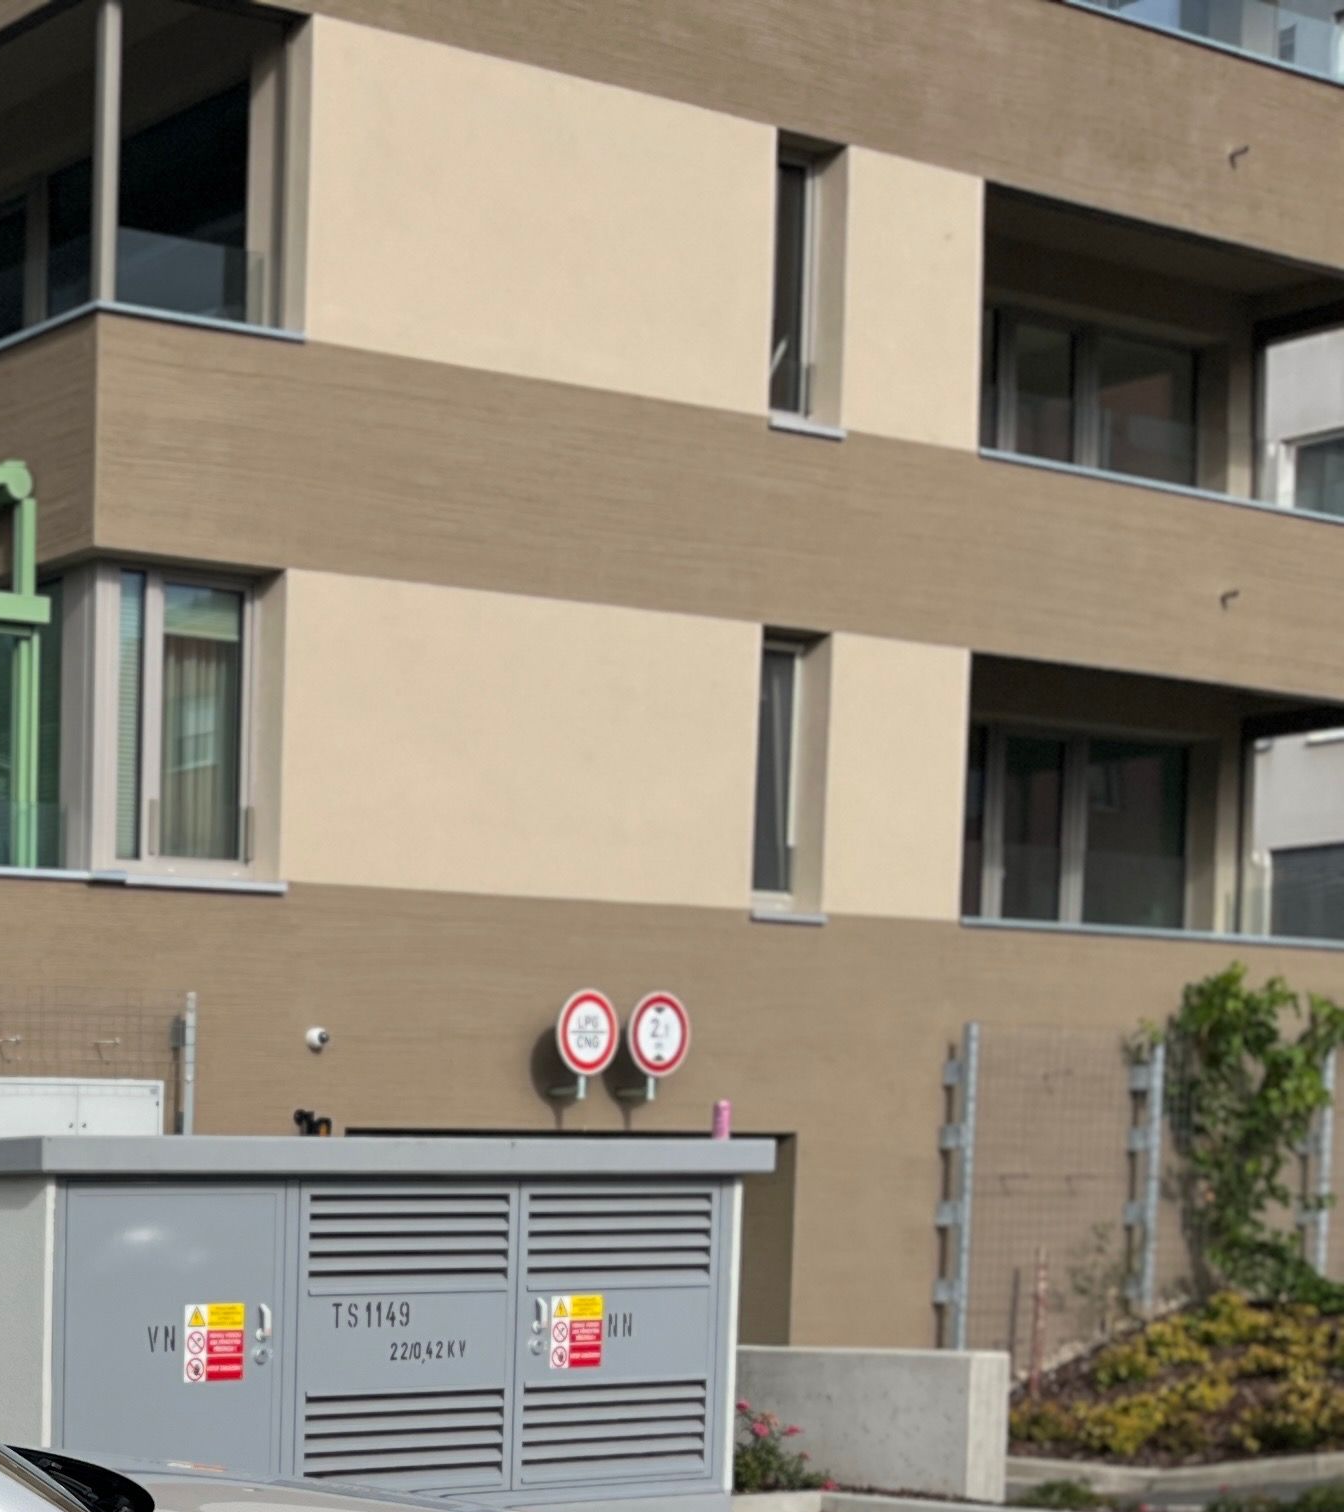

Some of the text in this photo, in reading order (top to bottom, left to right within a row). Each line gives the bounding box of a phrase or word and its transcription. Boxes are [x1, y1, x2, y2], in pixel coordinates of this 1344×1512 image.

[577, 1015, 599, 1029] LPG
[577, 1034, 599, 1049] CNG
[608, 1312, 632, 1337] NN
[147, 1325, 176, 1353] VN
